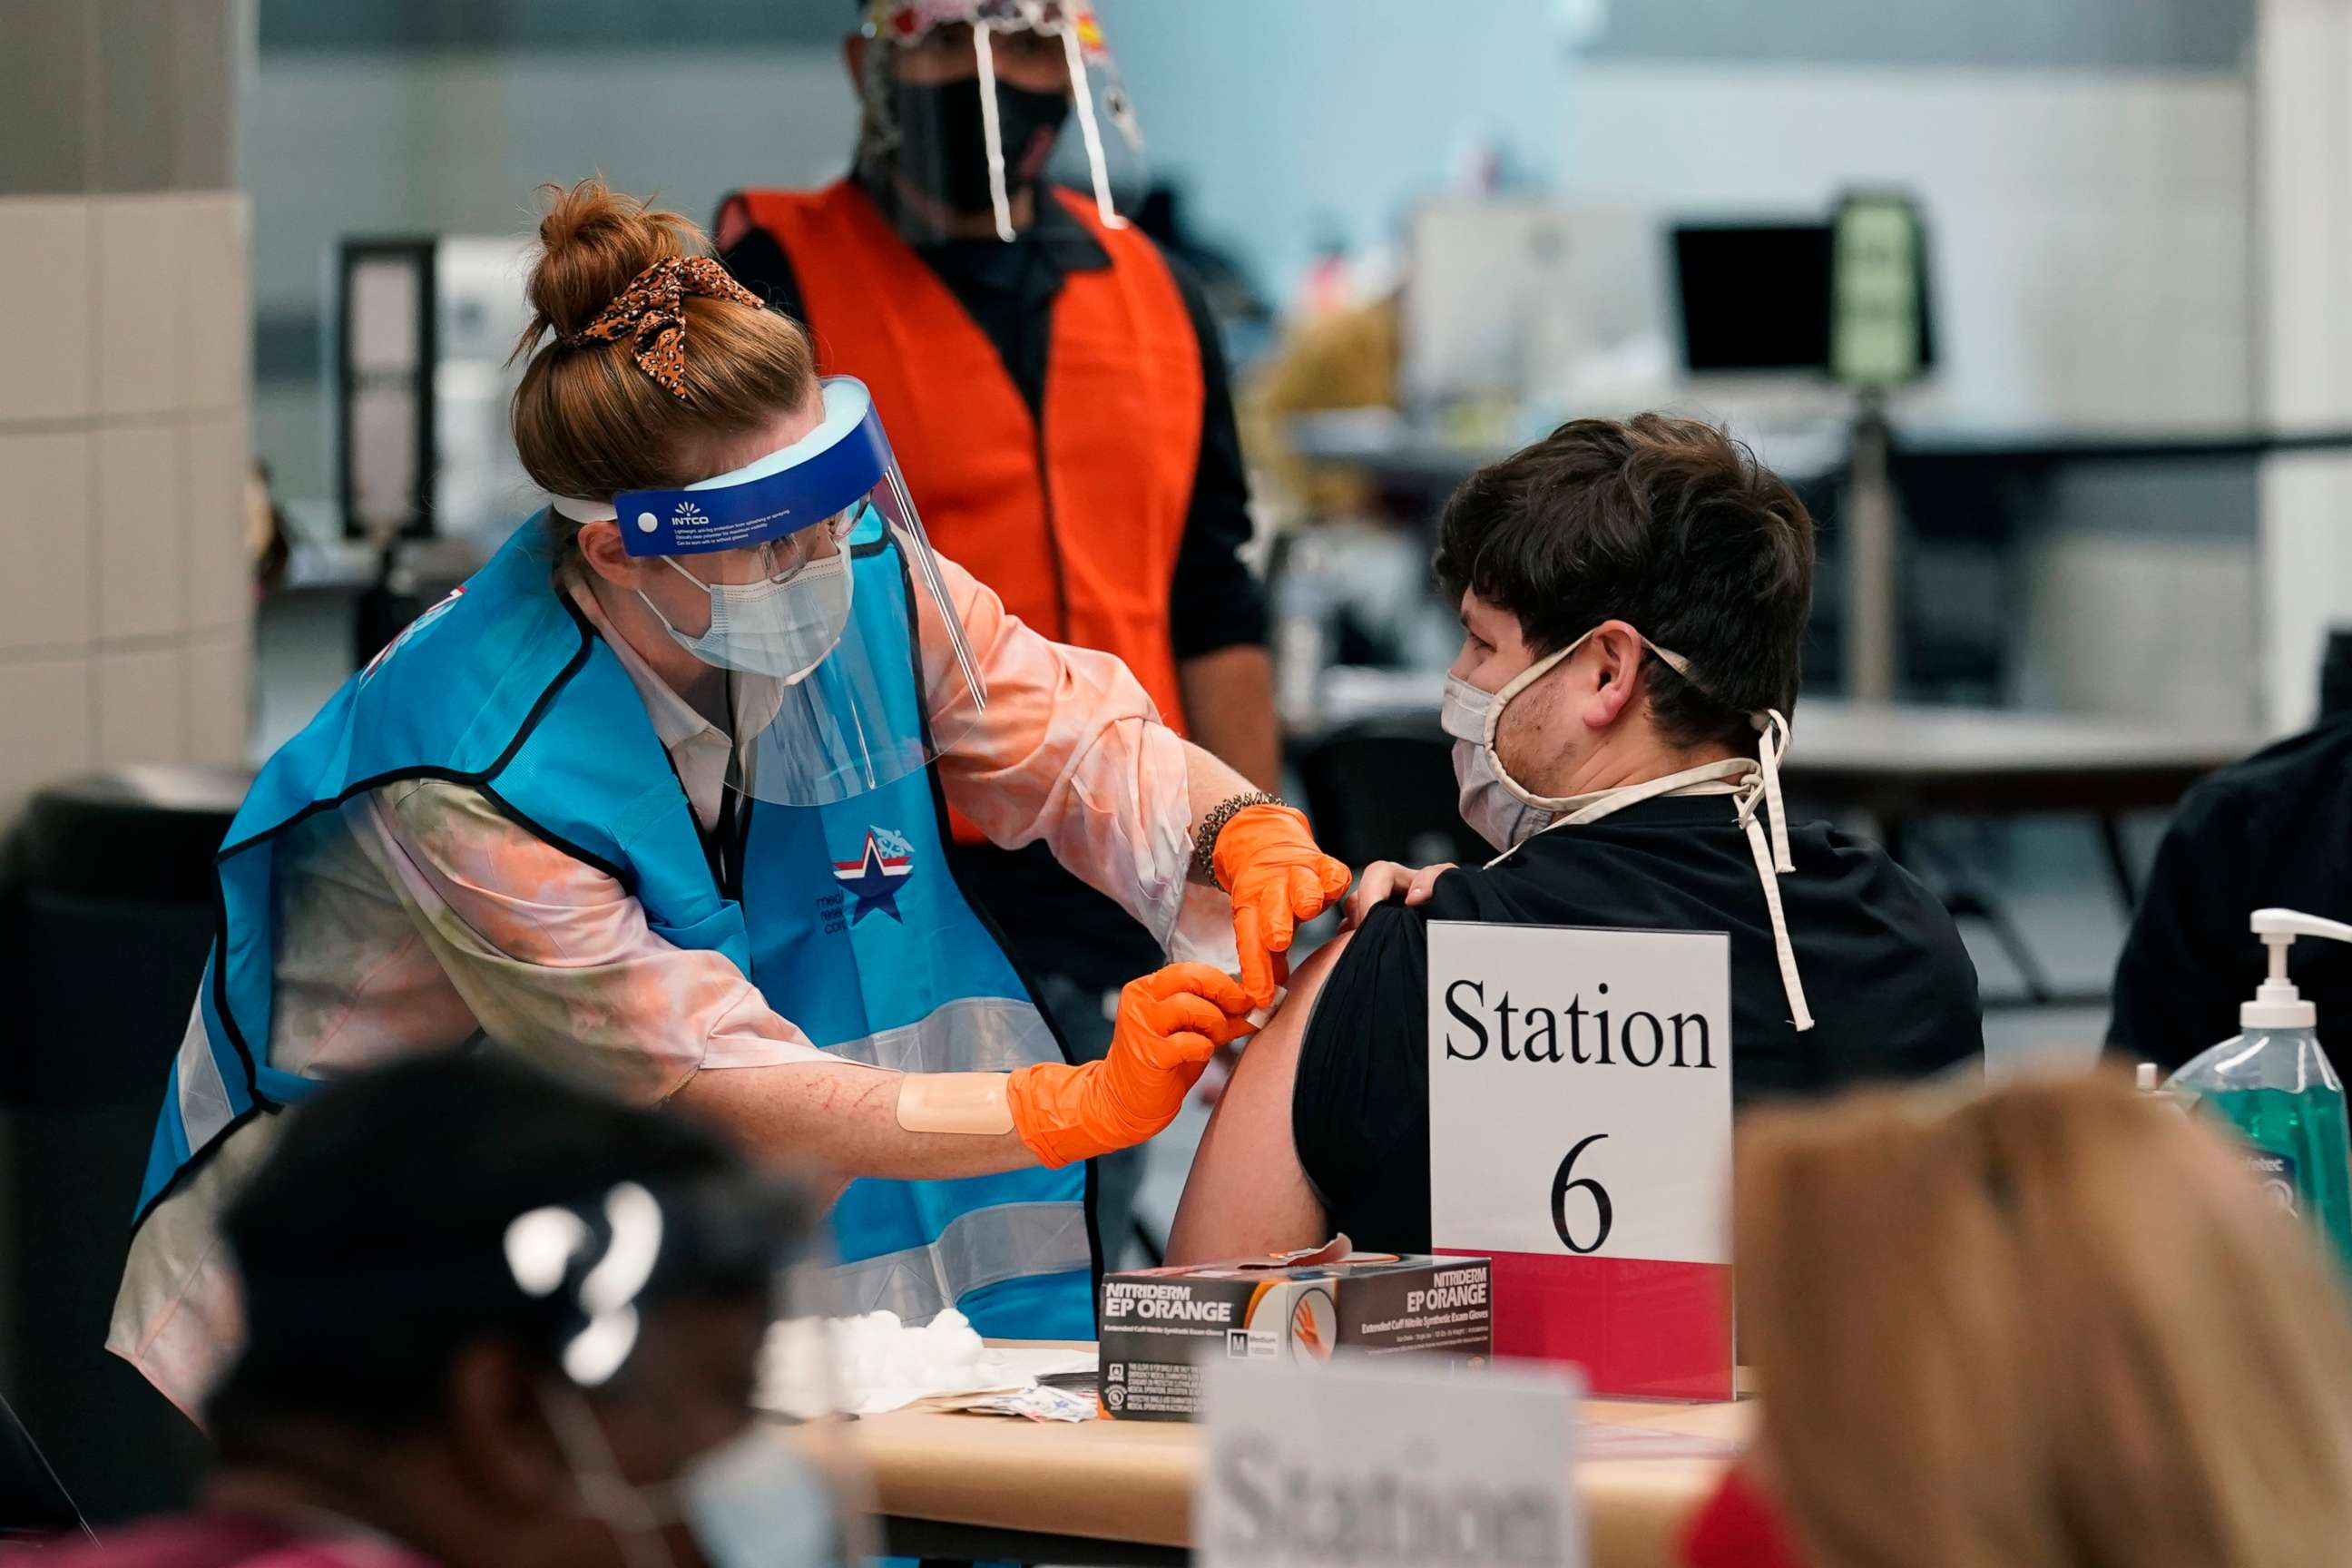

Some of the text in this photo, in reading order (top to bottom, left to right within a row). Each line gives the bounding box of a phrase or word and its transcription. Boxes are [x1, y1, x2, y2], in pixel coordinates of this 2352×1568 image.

[671, 516, 710, 525] INTCO
[1445, 980, 1717, 1069] Station
[1551, 1133, 1612, 1254] 6
[1434, 1267, 1488, 1289] NITRIDERM
[1105, 1282, 1191, 1301] NITRIDERM
[1406, 1283, 1487, 1313] EP ORANGE
[1105, 1298, 1231, 1322] EP ORANGE
[1361, 1320, 1391, 1335] Extended
[1391, 1318, 1405, 1330] Cuff
[1405, 1317, 1423, 1328] Nitrile
[1423, 1314, 1451, 1329] Synthetic
[1451, 1312, 1468, 1322] Exam
[1468, 1309, 1488, 1320] Gloves
[1232, 1335, 1245, 1351] M
